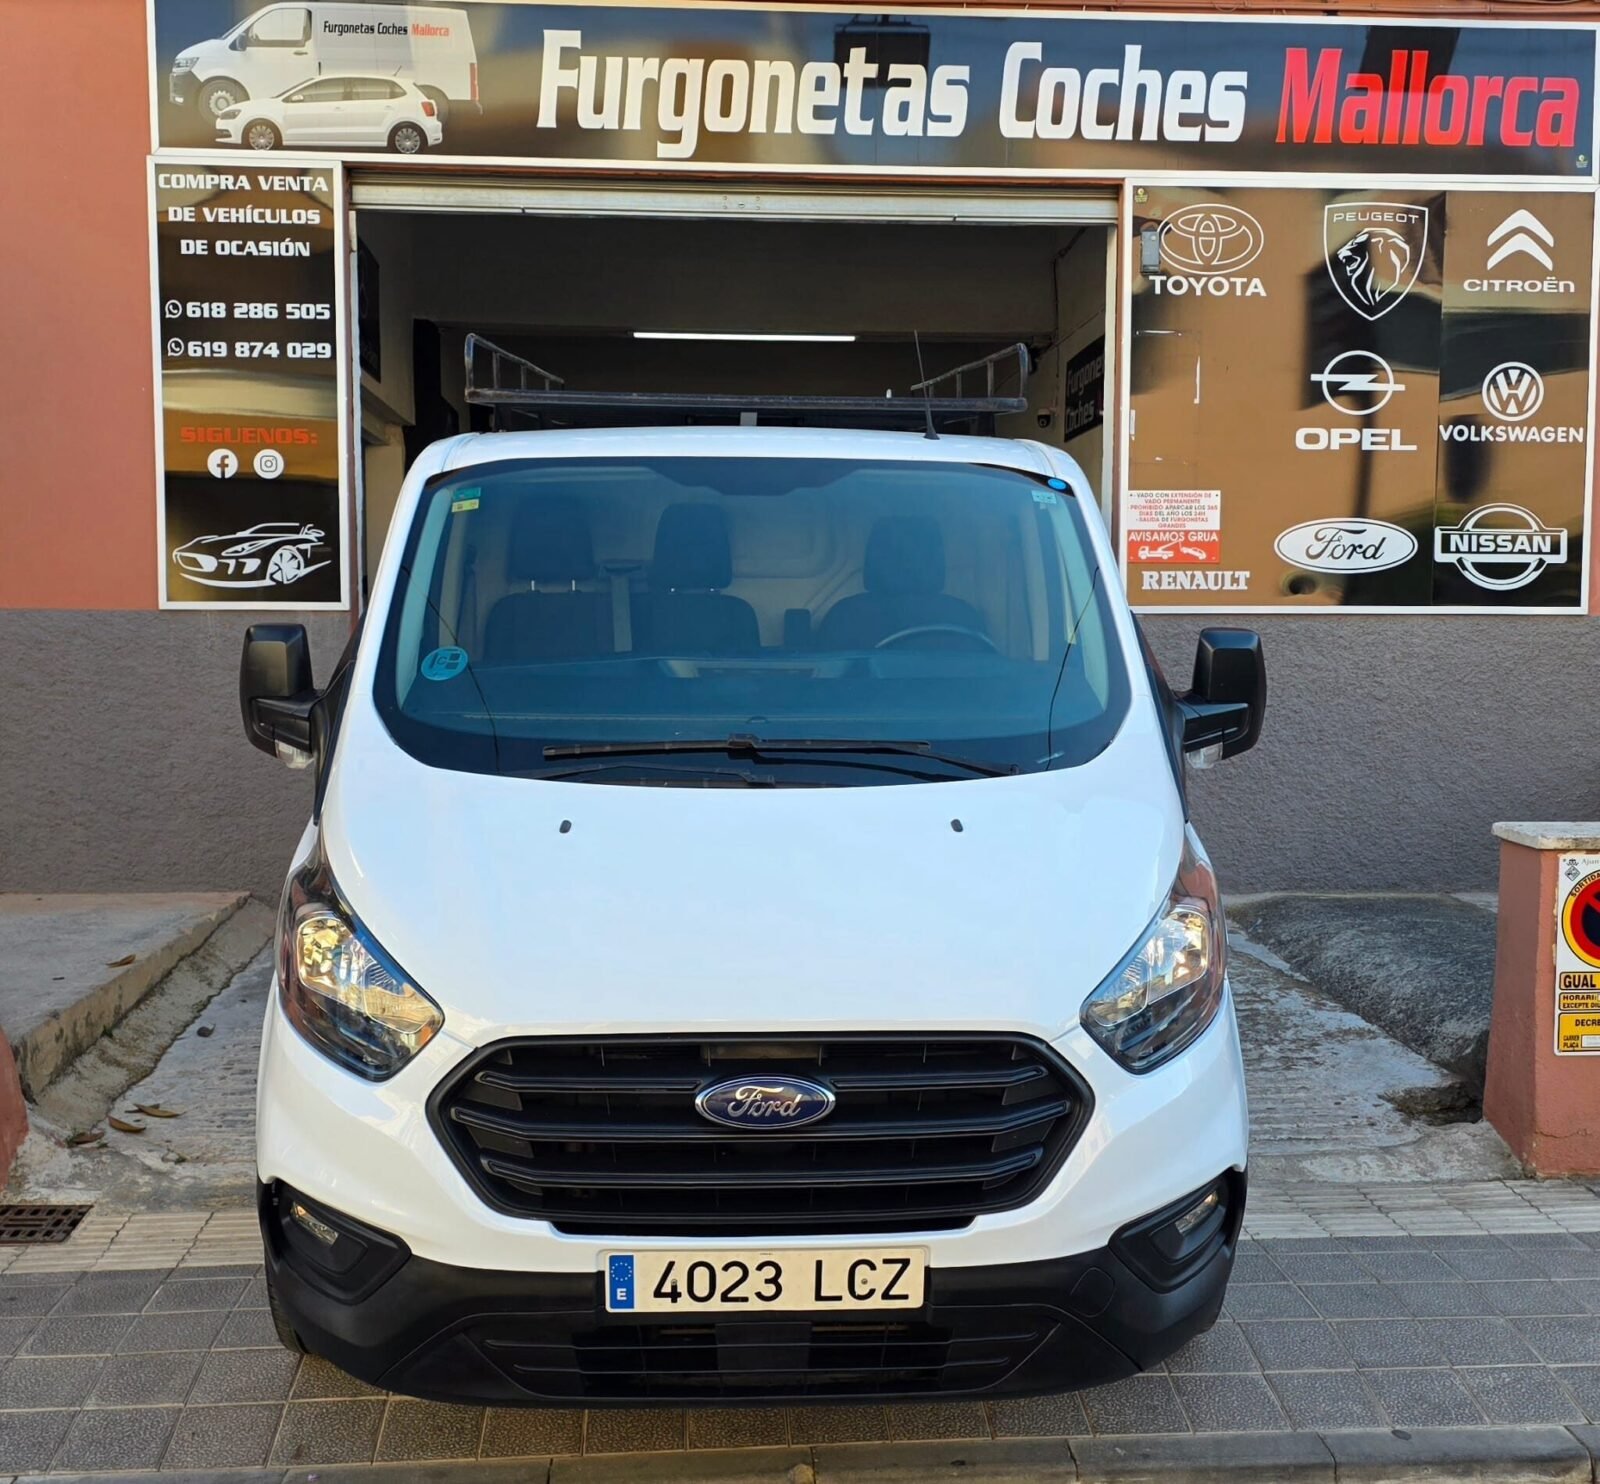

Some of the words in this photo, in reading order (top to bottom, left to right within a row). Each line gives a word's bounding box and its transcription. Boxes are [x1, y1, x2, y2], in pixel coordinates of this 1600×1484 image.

[323, 20, 375, 36] Furgonetas
[377, 22, 408, 35] Coches
[411, 23, 450, 37] Mallorca
[536, 29, 970, 158] Furgonetas
[998, 41, 1248, 142] Coches
[1275, 47, 1580, 148] Mallorca
[158, 173, 251, 190] COMPRA
[257, 175, 329, 192] VENTA
[168, 206, 195, 222] DE
[202, 205, 321, 224] VEHÍCULOS
[1332, 212, 1420, 225] PEUGEOT
[180, 239, 208, 255] DE
[215, 238, 310, 257] OCASIÓN
[1148, 275, 1267, 297] TOYOTA
[186, 301, 226, 319] 618
[233, 302, 279, 319] 286
[285, 303, 331, 320] 505
[187, 341, 228, 358] 619
[234, 341, 280, 358] 874
[286, 342, 332, 359] 029
[1067, 352, 1104, 396] Furgone
[1066, 400, 1095, 434] Coches
[180, 427, 318, 445] SIGUENOS:
[1295, 428, 1418, 451] OPEL
[1438, 424, 1584, 443] VOLKSWAGEN
[1128, 531, 1185, 542] AVISAMOS
[1187, 531, 1219, 542] GRUA
[1304, 527, 1388, 562] Ford
[1449, 534, 1552, 554] NISSAN
[1141, 571, 1250, 591] RENAULT
[1563, 974, 1596, 988] GUAL
[727, 1085, 803, 1118] Ford
[653, 1260, 783, 1303] 4023
[814, 1258, 911, 1302] LCZ
[616, 1288, 627, 1300] E
